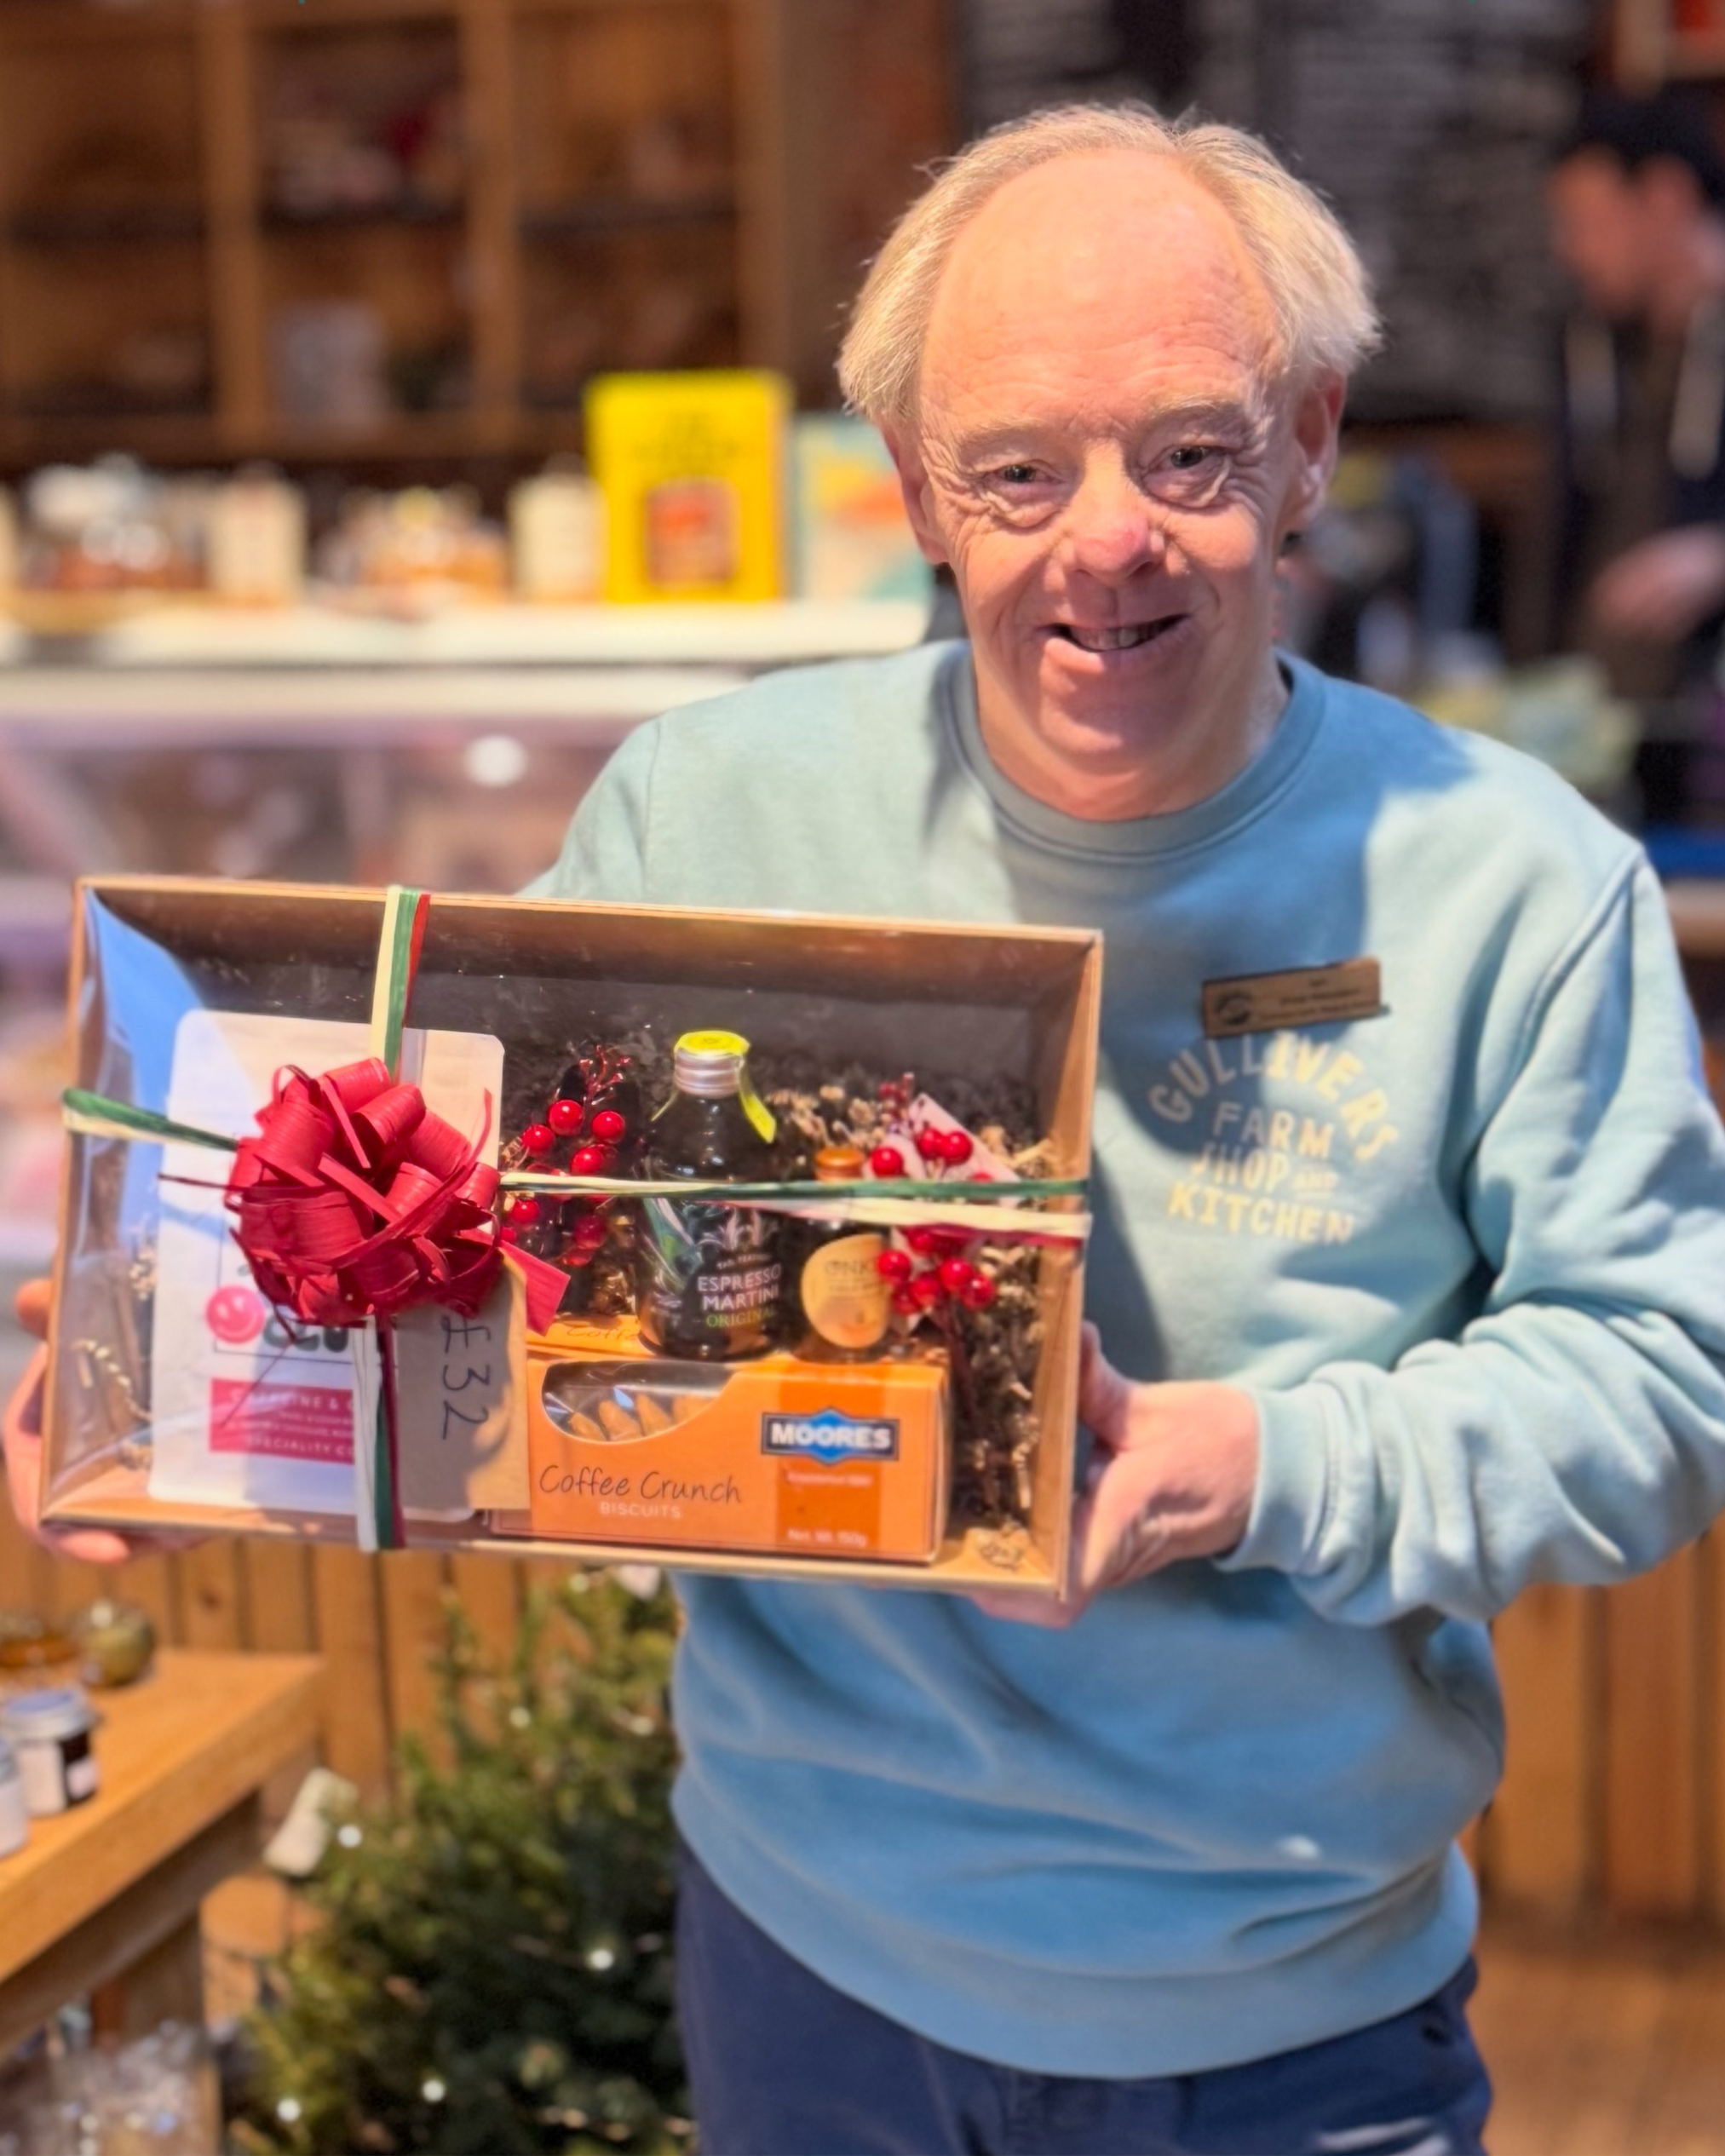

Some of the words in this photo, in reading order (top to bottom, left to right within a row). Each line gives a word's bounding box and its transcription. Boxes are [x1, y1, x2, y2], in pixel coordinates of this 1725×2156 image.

[1212, 1100, 1335, 1160] FARM
[1166, 1180, 1357, 1245] KITCHEN
[698, 1263, 781, 1293] ESPRESSO
[702, 1283, 779, 1311] MARTINI
[771, 1422, 891, 1450] MOORES
[539, 1464, 631, 1497] Coffee
[640, 1470, 742, 1503] Crunch
[599, 1500, 682, 1519] BISCUITS
